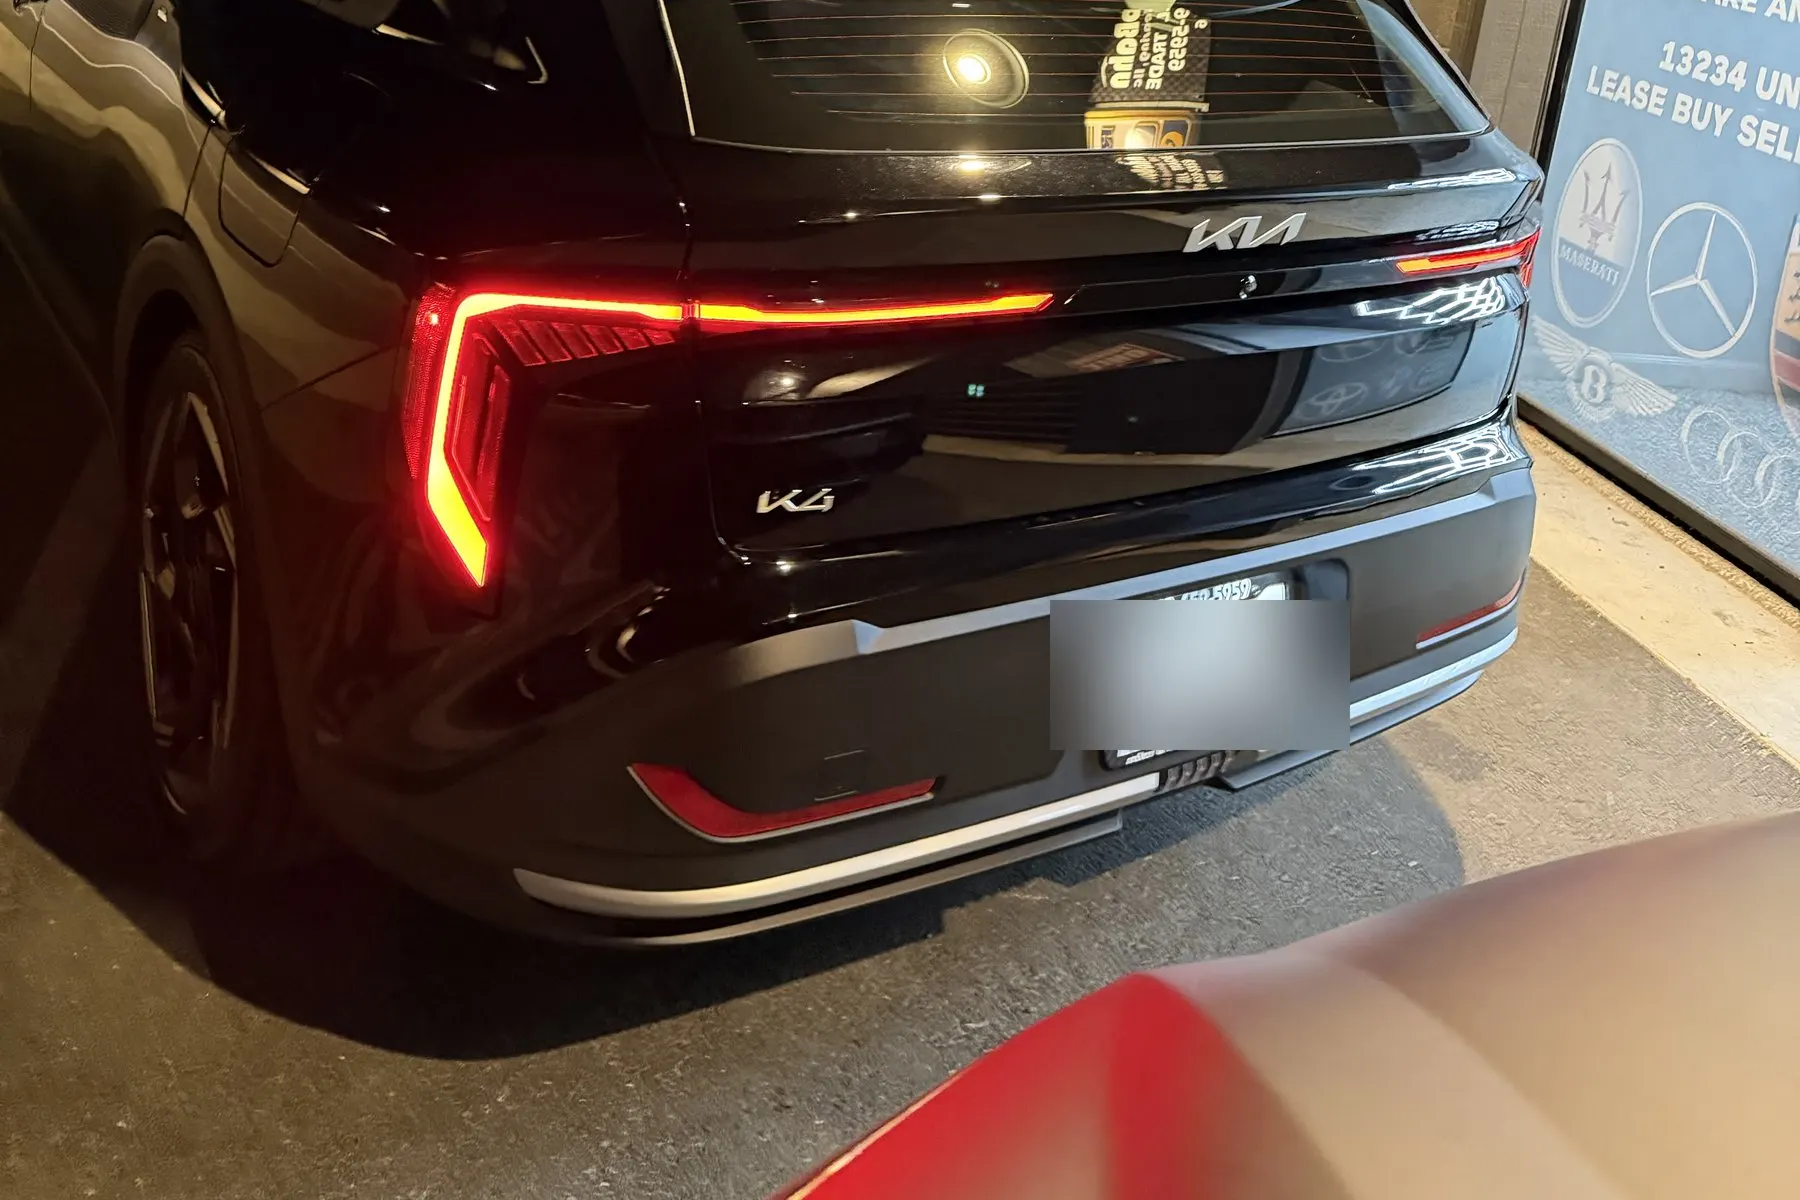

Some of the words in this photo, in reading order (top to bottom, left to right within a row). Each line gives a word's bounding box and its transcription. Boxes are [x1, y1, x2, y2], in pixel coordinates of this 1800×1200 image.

[1659, 41, 1748, 93] 13234
[1586, 65, 1669, 117] LEASE
[1671, 92, 1734, 138] BUY
[1182, 212, 1307, 253] KIA
[1558, 243, 1620, 286] MASERATI
[756, 488, 835, 514] K4
